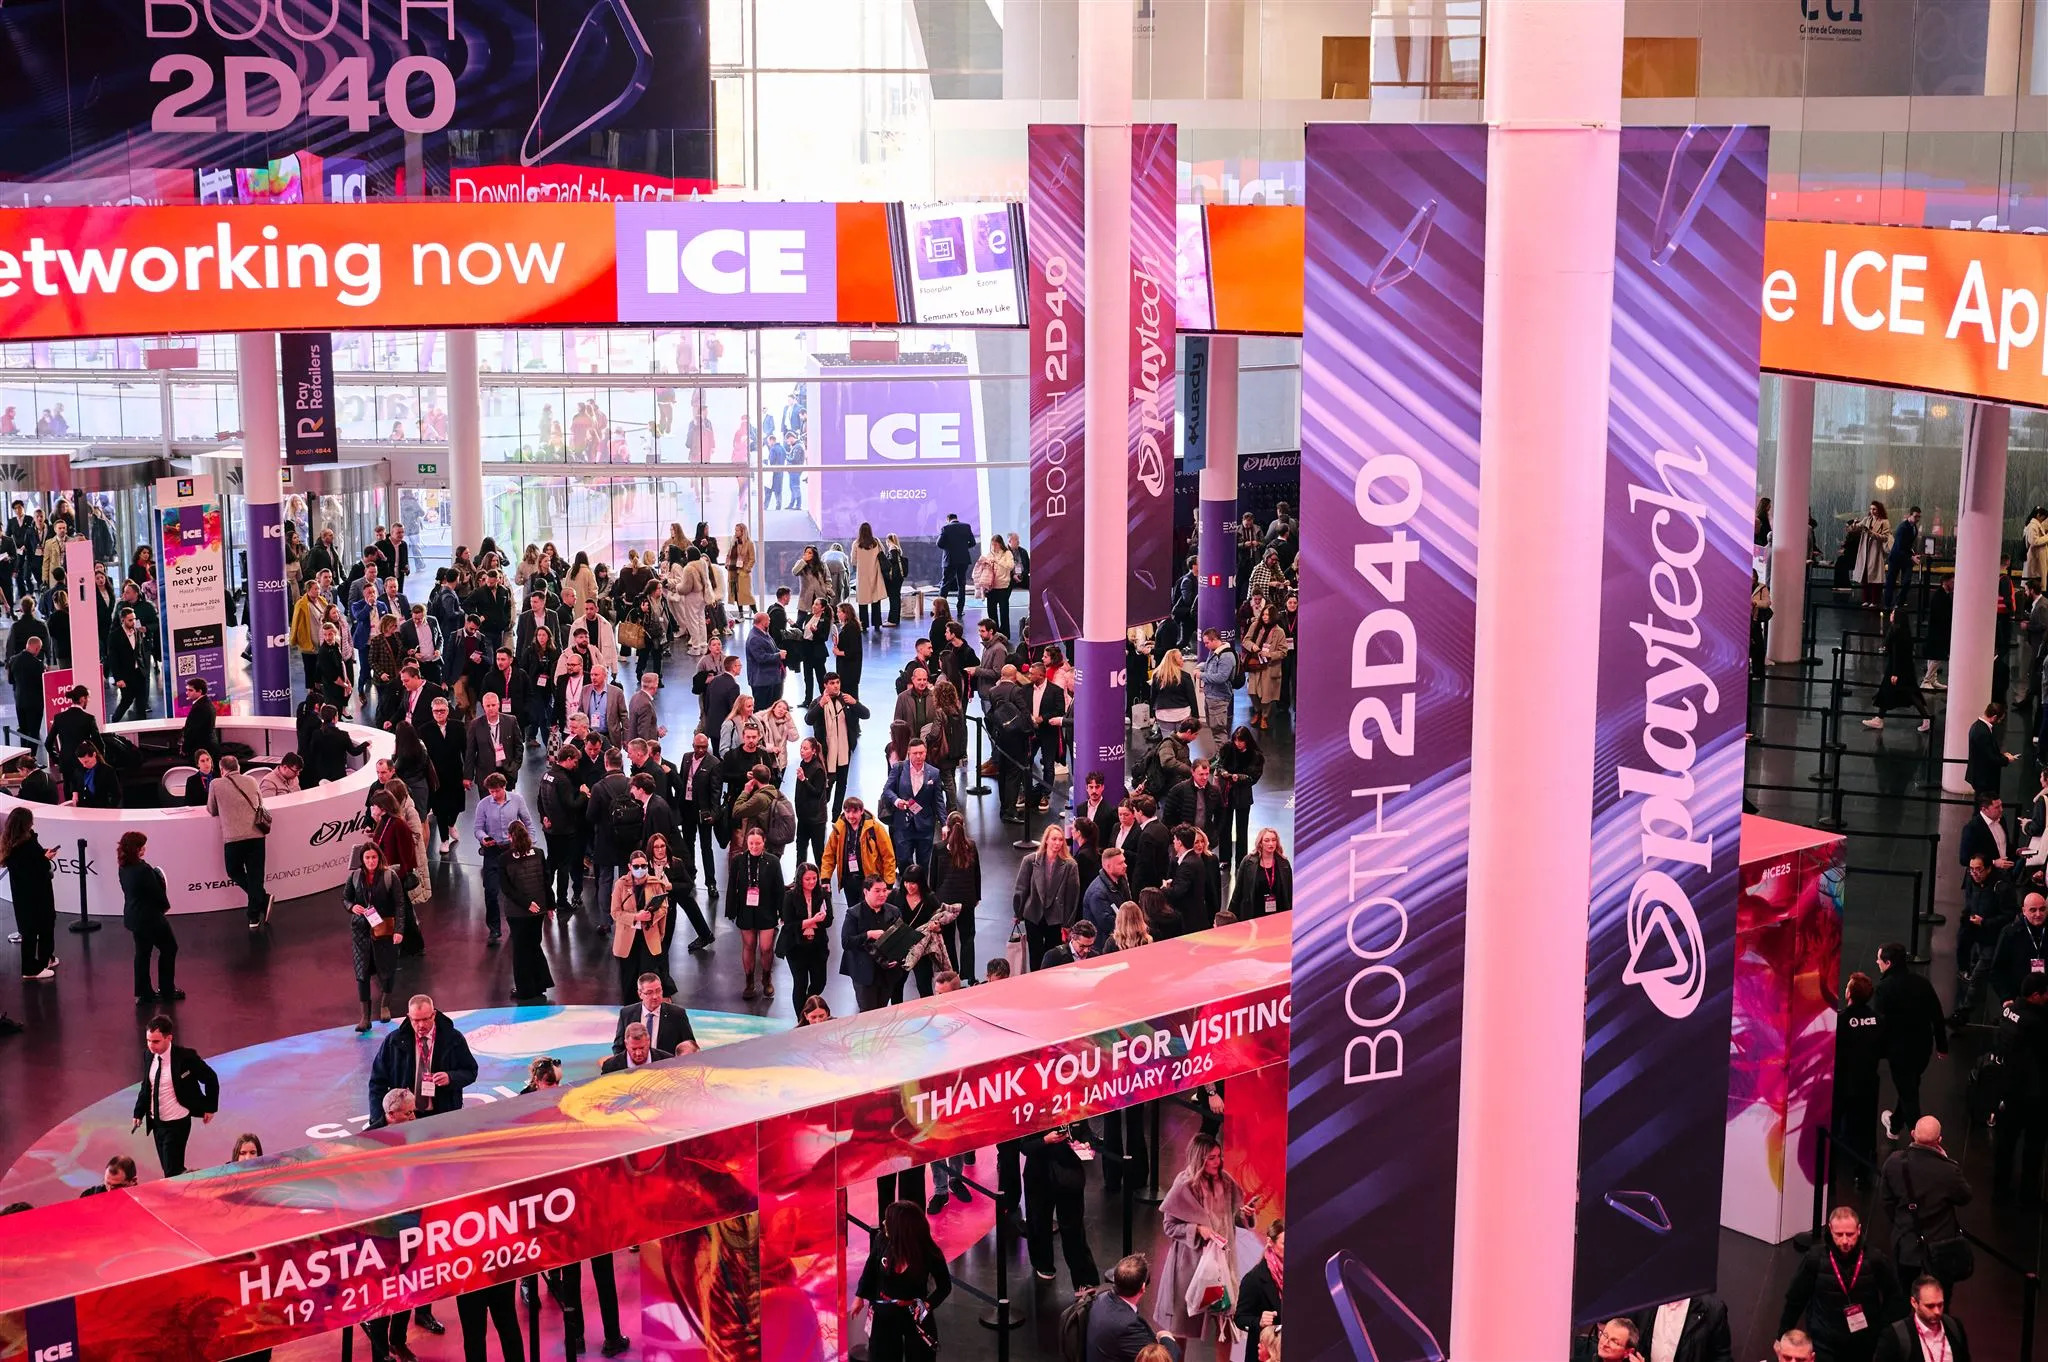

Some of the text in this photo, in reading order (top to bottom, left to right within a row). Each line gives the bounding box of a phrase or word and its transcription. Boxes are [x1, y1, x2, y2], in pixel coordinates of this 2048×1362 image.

[150, 54, 456, 133] 2D40
[412, 241, 566, 286] now
[645, 228, 807, 295] ICE
[923, 312, 958, 322] Seminars
[976, 307, 992, 315] May
[995, 305, 1011, 313] Like
[1822, 250, 1928, 335] ICE
[1945, 260, 2048, 376] Ap
[1134, 254, 1167, 434] playtech
[296, 382, 310, 409] Pay
[308, 344, 323, 409] Retailers
[1046, 256, 1068, 518] BOOTH 2D40
[845, 413, 960, 460] ICE
[1259, 453, 1300, 471] playtech
[880, 489, 927, 500] #ICE2025
[183, 529, 202, 540] ICE
[172, 574, 218, 588] next year
[175, 564, 214, 576] See you
[1617, 444, 1713, 874] playtech
[52, 696, 73, 706] YOU
[58, 685, 74, 695] PIC
[1344, 454, 1423, 1084] BOOTH 2D40
[188, 882, 201, 892] 25
[265, 867, 300, 882] EADING
[1762, 863, 1791, 880] #ICE25
[1860, 1017, 1877, 1026] ICE
[910, 1069, 1027, 1125] THANK
[1033, 1045, 1100, 1091] YOU
[1111, 1028, 1173, 1071] FOR
[1011, 1102, 1034, 1126] 19
[1052, 1090, 1072, 1115] 21
[1079, 1064, 1167, 1108] JANUARY
[1172, 1053, 1214, 1081] 2026
[239, 1187, 576, 1306] HASTA PRONTO
[283, 1299, 315, 1326] 19
[341, 1284, 369, 1312] 21
[382, 1257, 474, 1300] ENERO
[482, 1237, 542, 1273] 2026
[34, 1342, 73, 1362] ICE
